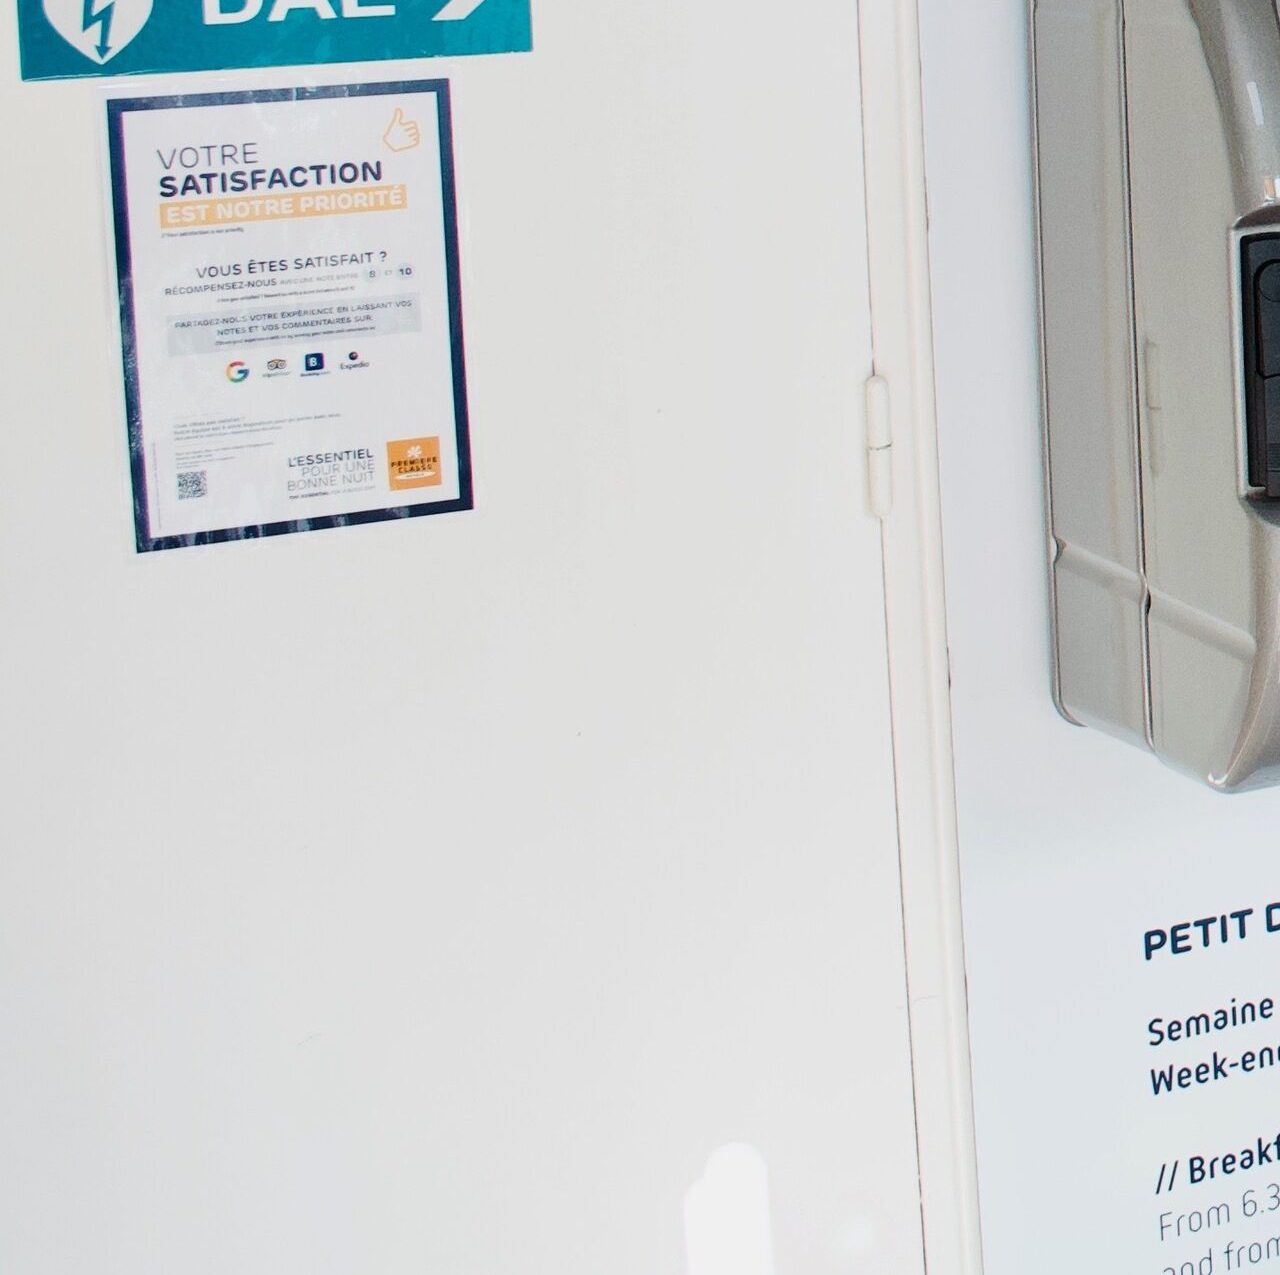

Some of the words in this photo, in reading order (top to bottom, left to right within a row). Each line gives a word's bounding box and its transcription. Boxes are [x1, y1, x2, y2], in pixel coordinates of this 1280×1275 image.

[156, 141, 259, 171] VOTRE
[159, 160, 383, 198] SATISFACTION
[165, 204, 210, 224] EST
[216, 197, 294, 220] NOTRE
[299, 185, 403, 212] PRIORITÉ
[196, 263, 243, 279] VOUS
[247, 259, 289, 274] ÊTES
[293, 252, 374, 270] SATISFAIT
[379, 250, 388, 263] ?
[164, 277, 278, 297] RÉCOMPENSEZ-NOUS
[288, 448, 374, 468] L'ESSENTIEL
[301, 464, 343, 477] POUR
[345, 459, 375, 471] UNE
[287, 476, 339, 491] BONNE
[342, 470, 374, 483] NUIT
[1143, 906, 1254, 961] PETIT
[1147, 990, 1274, 1048] Semaine
